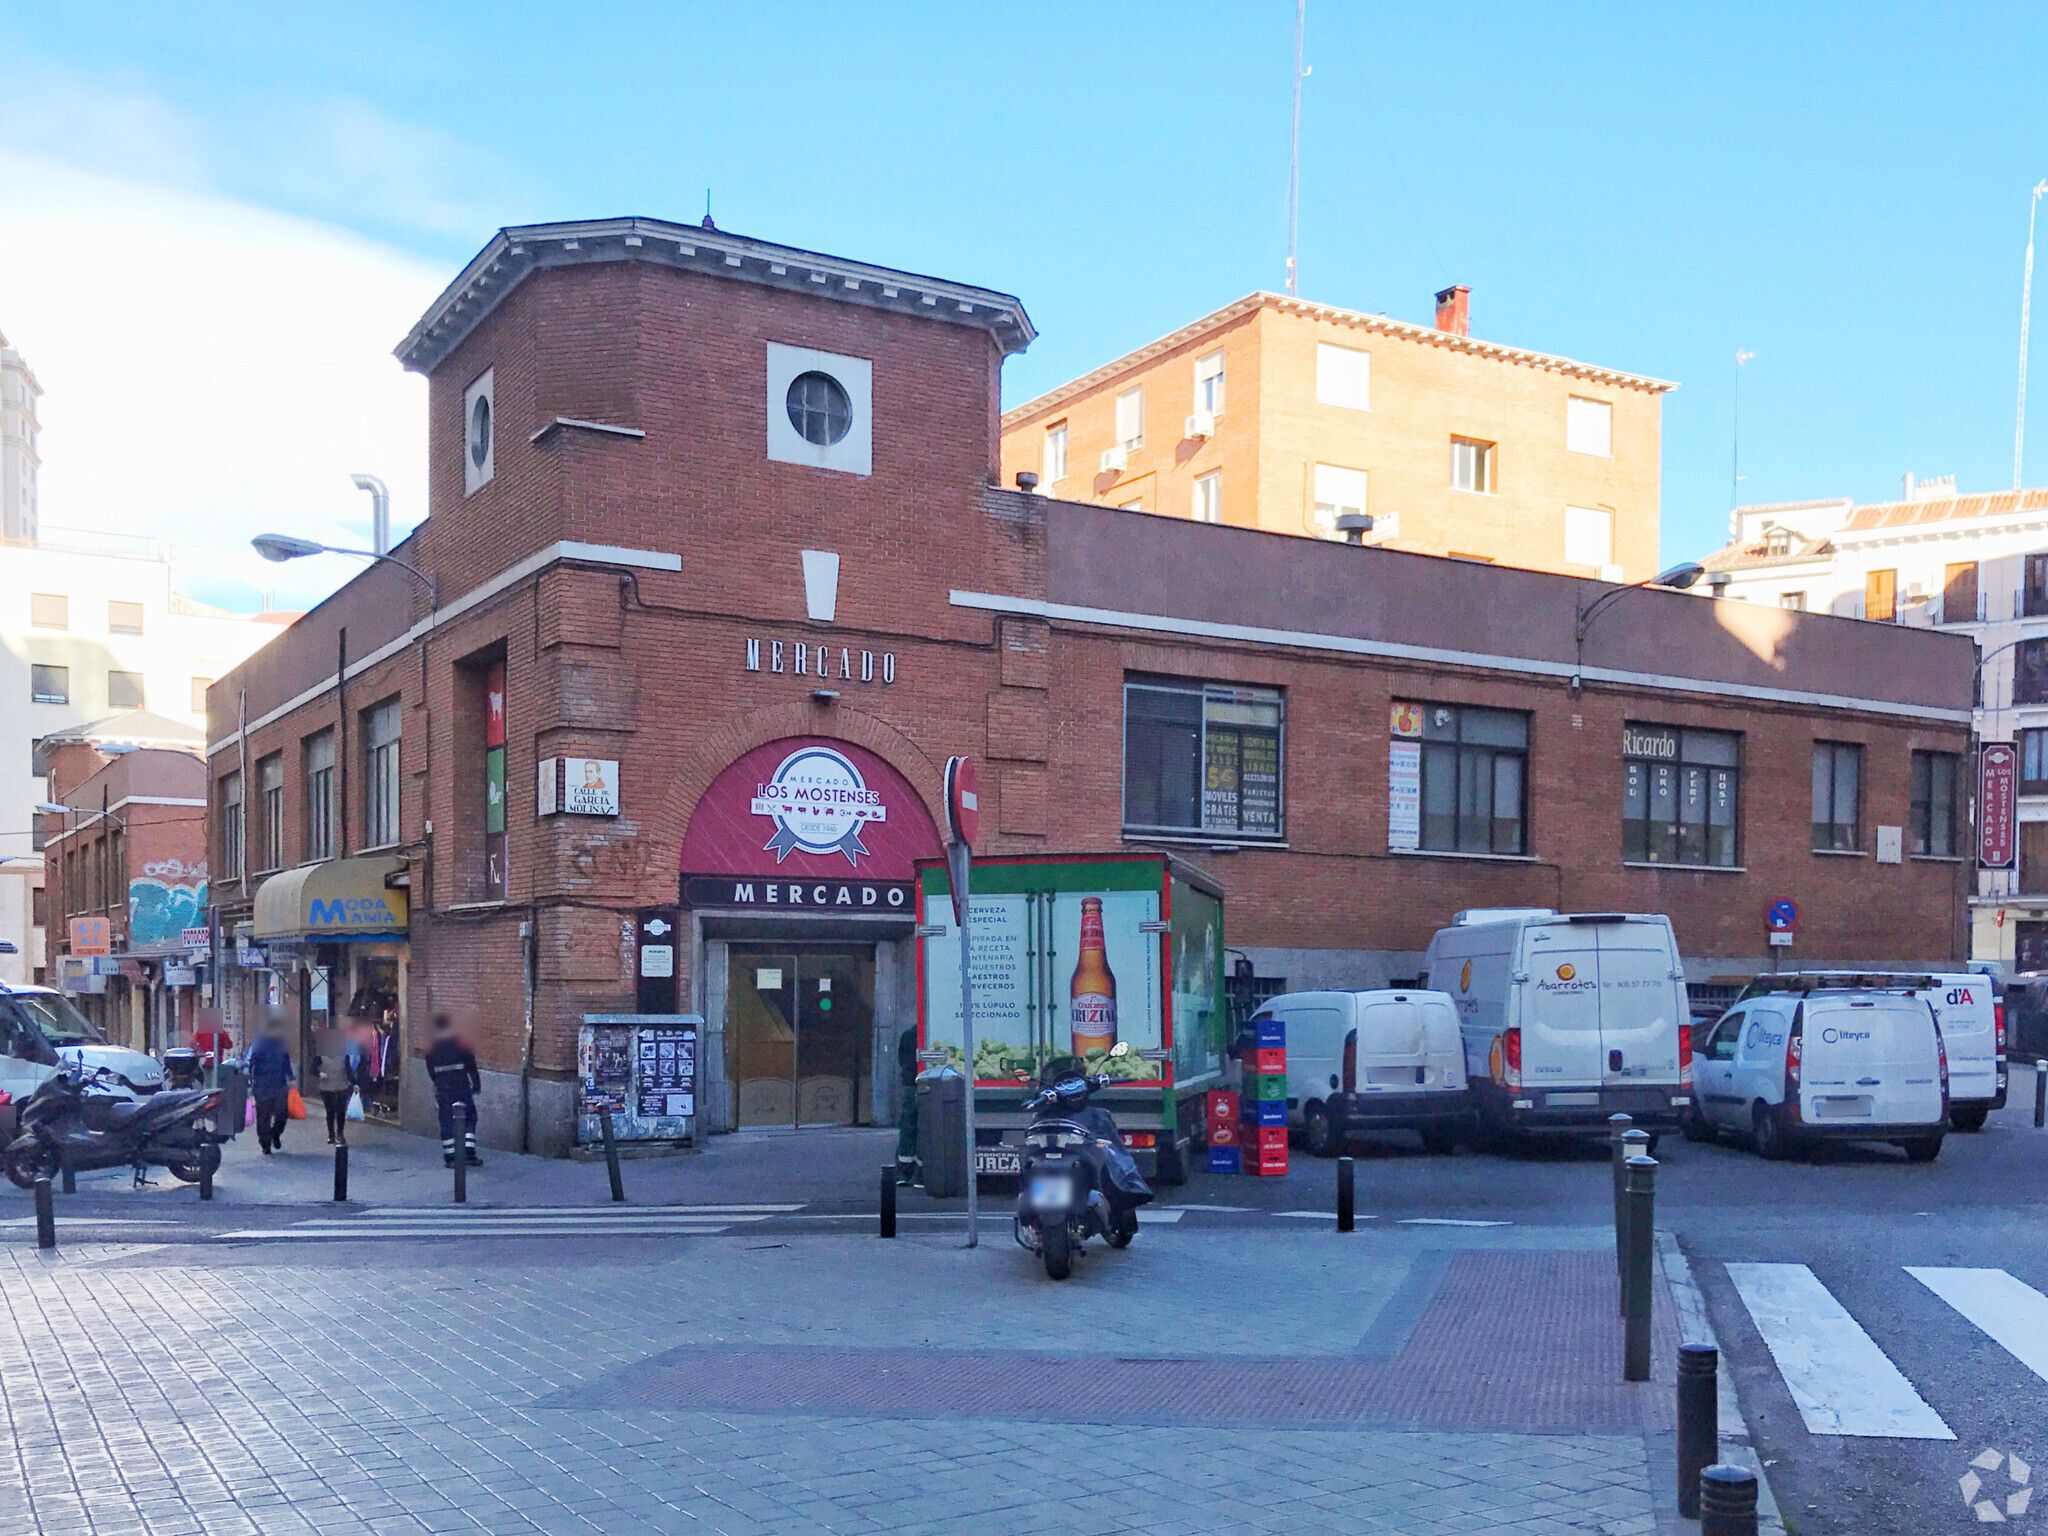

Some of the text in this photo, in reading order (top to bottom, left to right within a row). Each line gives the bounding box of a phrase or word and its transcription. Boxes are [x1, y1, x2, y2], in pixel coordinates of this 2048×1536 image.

[746, 638, 895, 684] MERCADO
[1623, 728, 1675, 757] Ricardo
[790, 776, 849, 786] MERCADO
[759, 784, 880, 804] LOS MOSTENSES
[569, 804, 614, 815] MOLINAS
[1205, 804, 1237, 816] GRATIS
[1985, 769, 1995, 846] MERCADO
[2000, 777, 2008, 847] MOSTENSES
[1243, 810, 1275, 823] VENTA
[801, 824, 820, 832] DESDE
[734, 883, 904, 906] MERCADO
[1537, 979, 1596, 990] Abarrotes
[1946, 988, 1974, 1005] d'A
[983, 1001, 1015, 1009] LÚPULO
[1758, 1026, 1782, 1048] liteyca
[1840, 1031, 1870, 1041] liteyca
